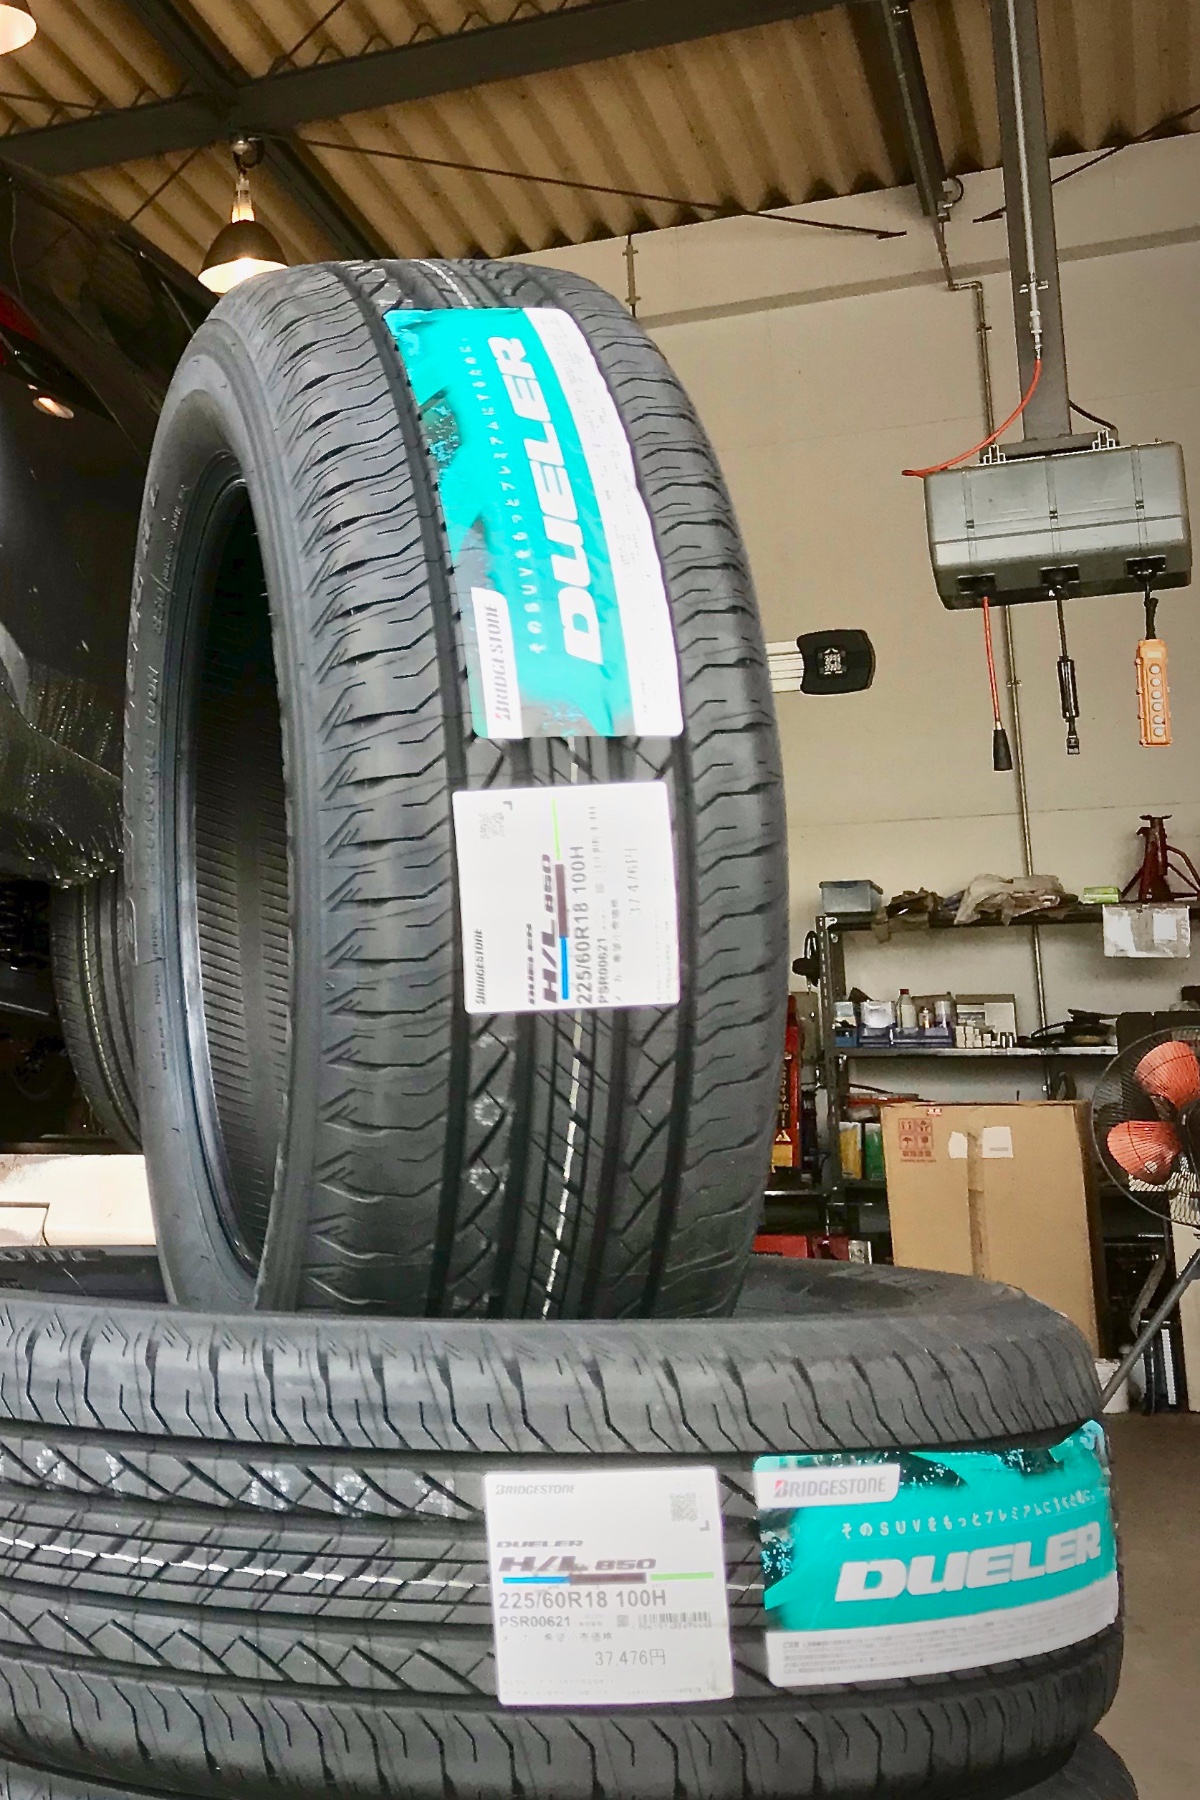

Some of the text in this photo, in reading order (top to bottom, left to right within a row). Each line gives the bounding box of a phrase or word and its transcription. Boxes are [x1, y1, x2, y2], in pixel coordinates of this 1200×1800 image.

[487, 337, 603, 665] DUELER
[483, 603, 513, 721] BRIDGESTONE
[570, 846, 593, 1006] 225/60R18 100H
[541, 918, 558, 1003] H/L
[597, 937, 611, 1004] PSR00621
[495, 1484, 576, 1496] BRIDGESTONE
[774, 1477, 887, 1499] BRIDGESTONE
[496, 1540, 584, 1549] DUELER
[498, 1556, 657, 1573] H/L 850
[835, 1521, 1102, 1603] DUELER
[498, 1589, 667, 1610] 225/60R18 100H
[499, 1615, 571, 1628] PSR00621
